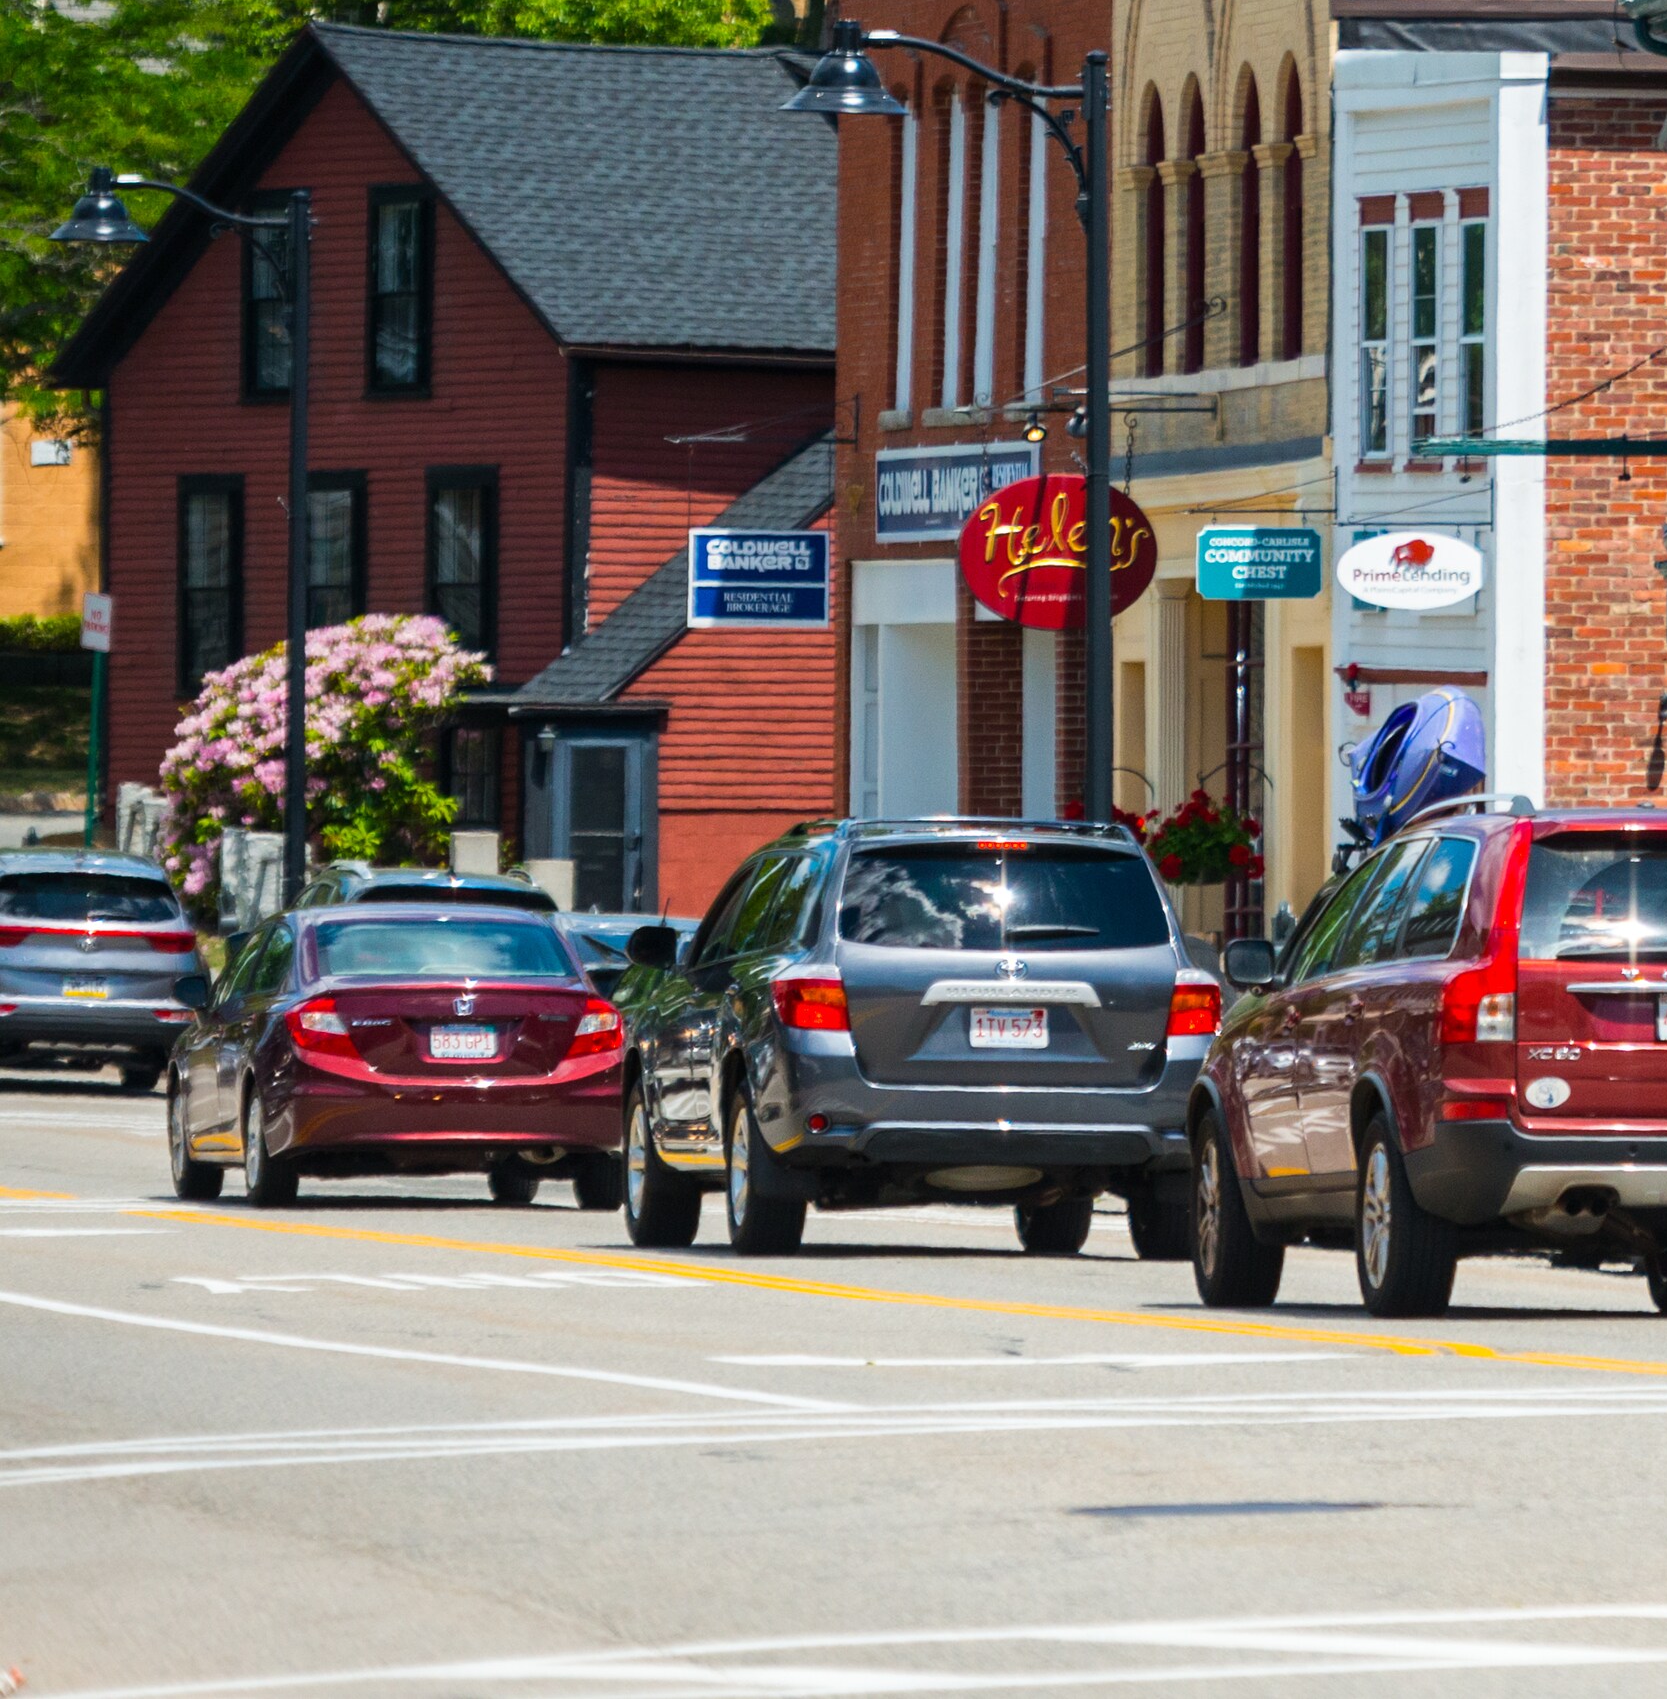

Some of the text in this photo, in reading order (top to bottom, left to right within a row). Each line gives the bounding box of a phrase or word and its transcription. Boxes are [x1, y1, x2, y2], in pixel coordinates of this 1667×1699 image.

[879, 469, 930, 516] COLDWELL
[932, 466, 978, 520] BANKER
[706, 539, 811, 555] COLDWELL
[1209, 537, 1309, 547] CONCORD-CARLISLE
[707, 554, 792, 572] BANKER
[1205, 549, 1315, 563] COMMUNITY
[1232, 566, 1287, 579] CHEST
[1353, 568, 1471, 585] PrimeLending
[724, 592, 794, 603] RESIDENTIAL
[726, 603, 791, 613] BROKERAGE
[1350, 694, 1368, 703] FIRE
[947, 987, 1079, 998] HIGHLANDER
[976, 1018, 1043, 1038] 1TV 573
[433, 1034, 492, 1050] 583 GP1
